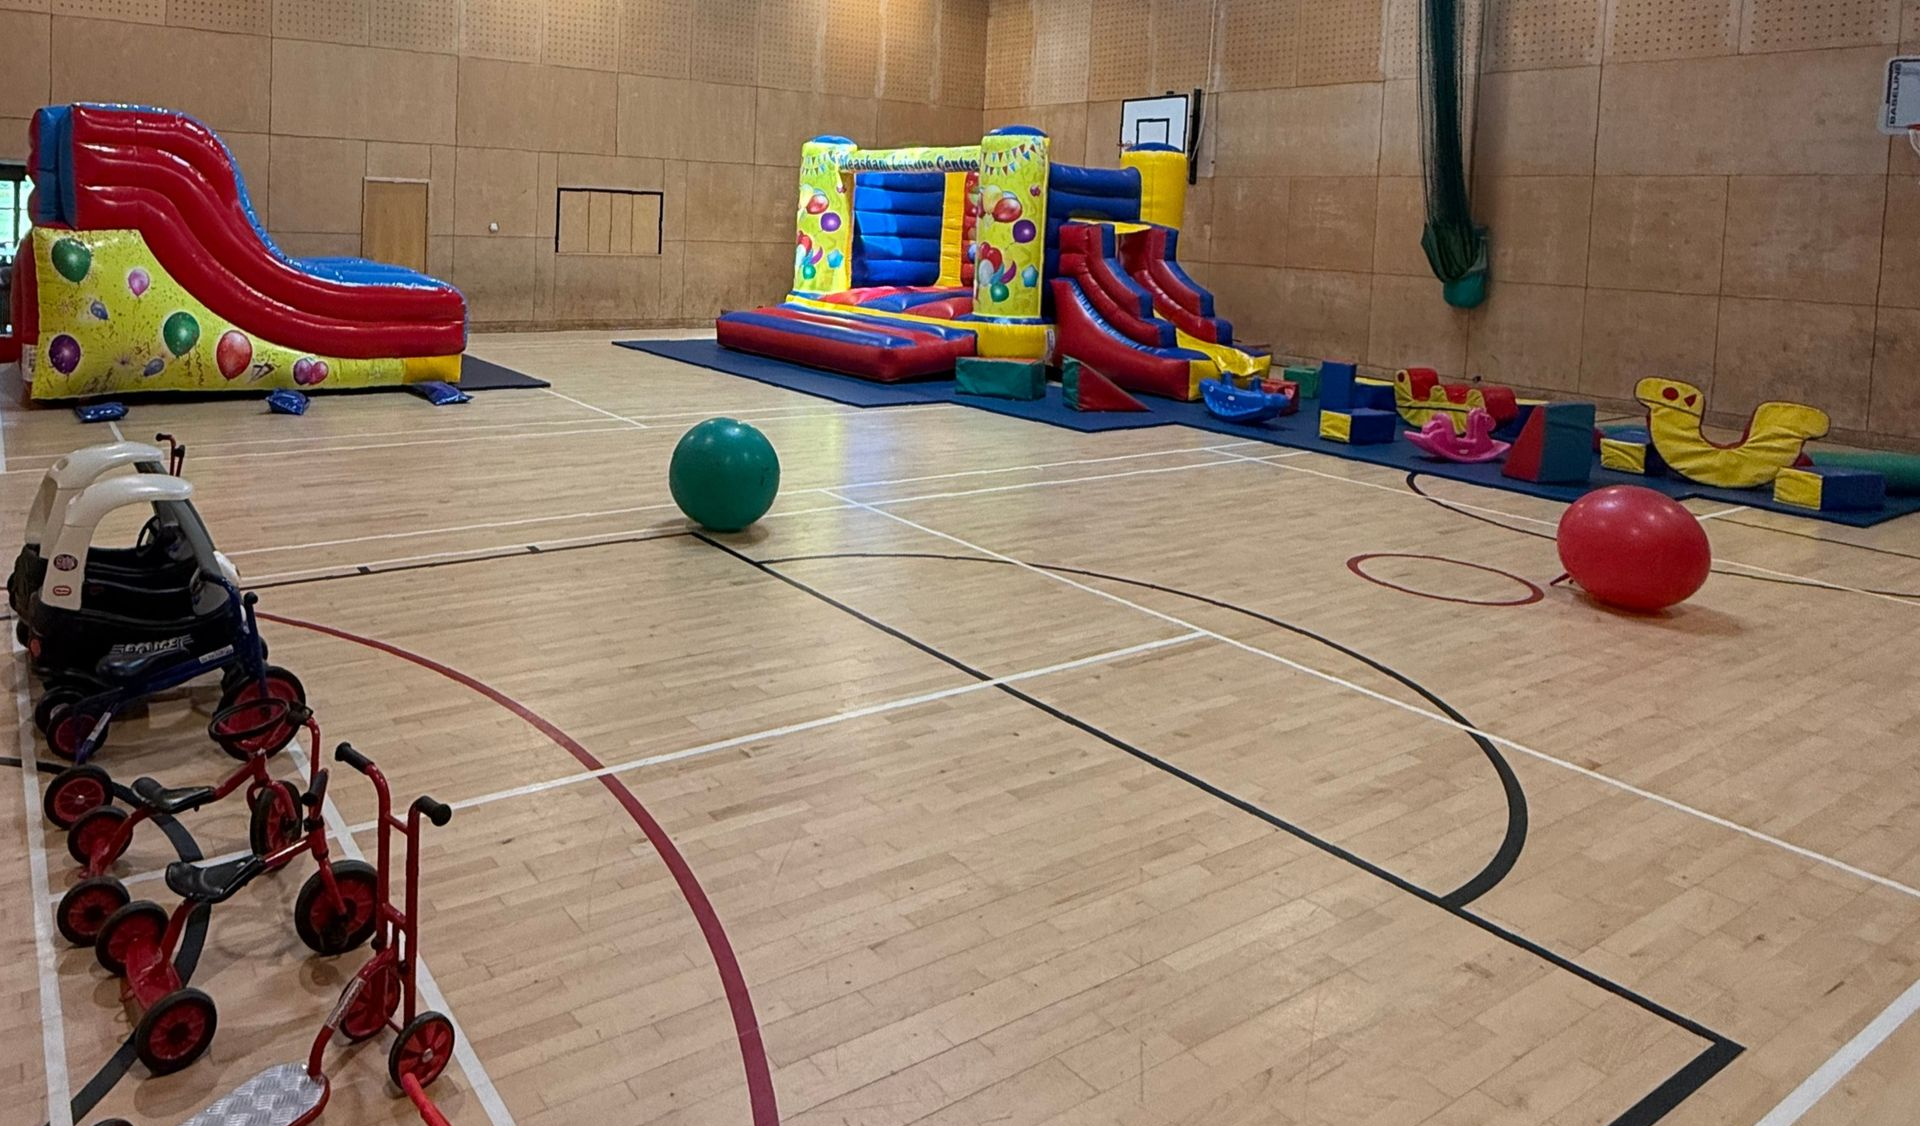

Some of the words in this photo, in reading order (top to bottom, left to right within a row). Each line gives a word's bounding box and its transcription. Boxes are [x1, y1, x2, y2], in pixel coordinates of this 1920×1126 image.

[1889, 63, 1901, 124] BASELINE
[891, 155, 934, 170] Leisure
[936, 155, 980, 172] Centre
